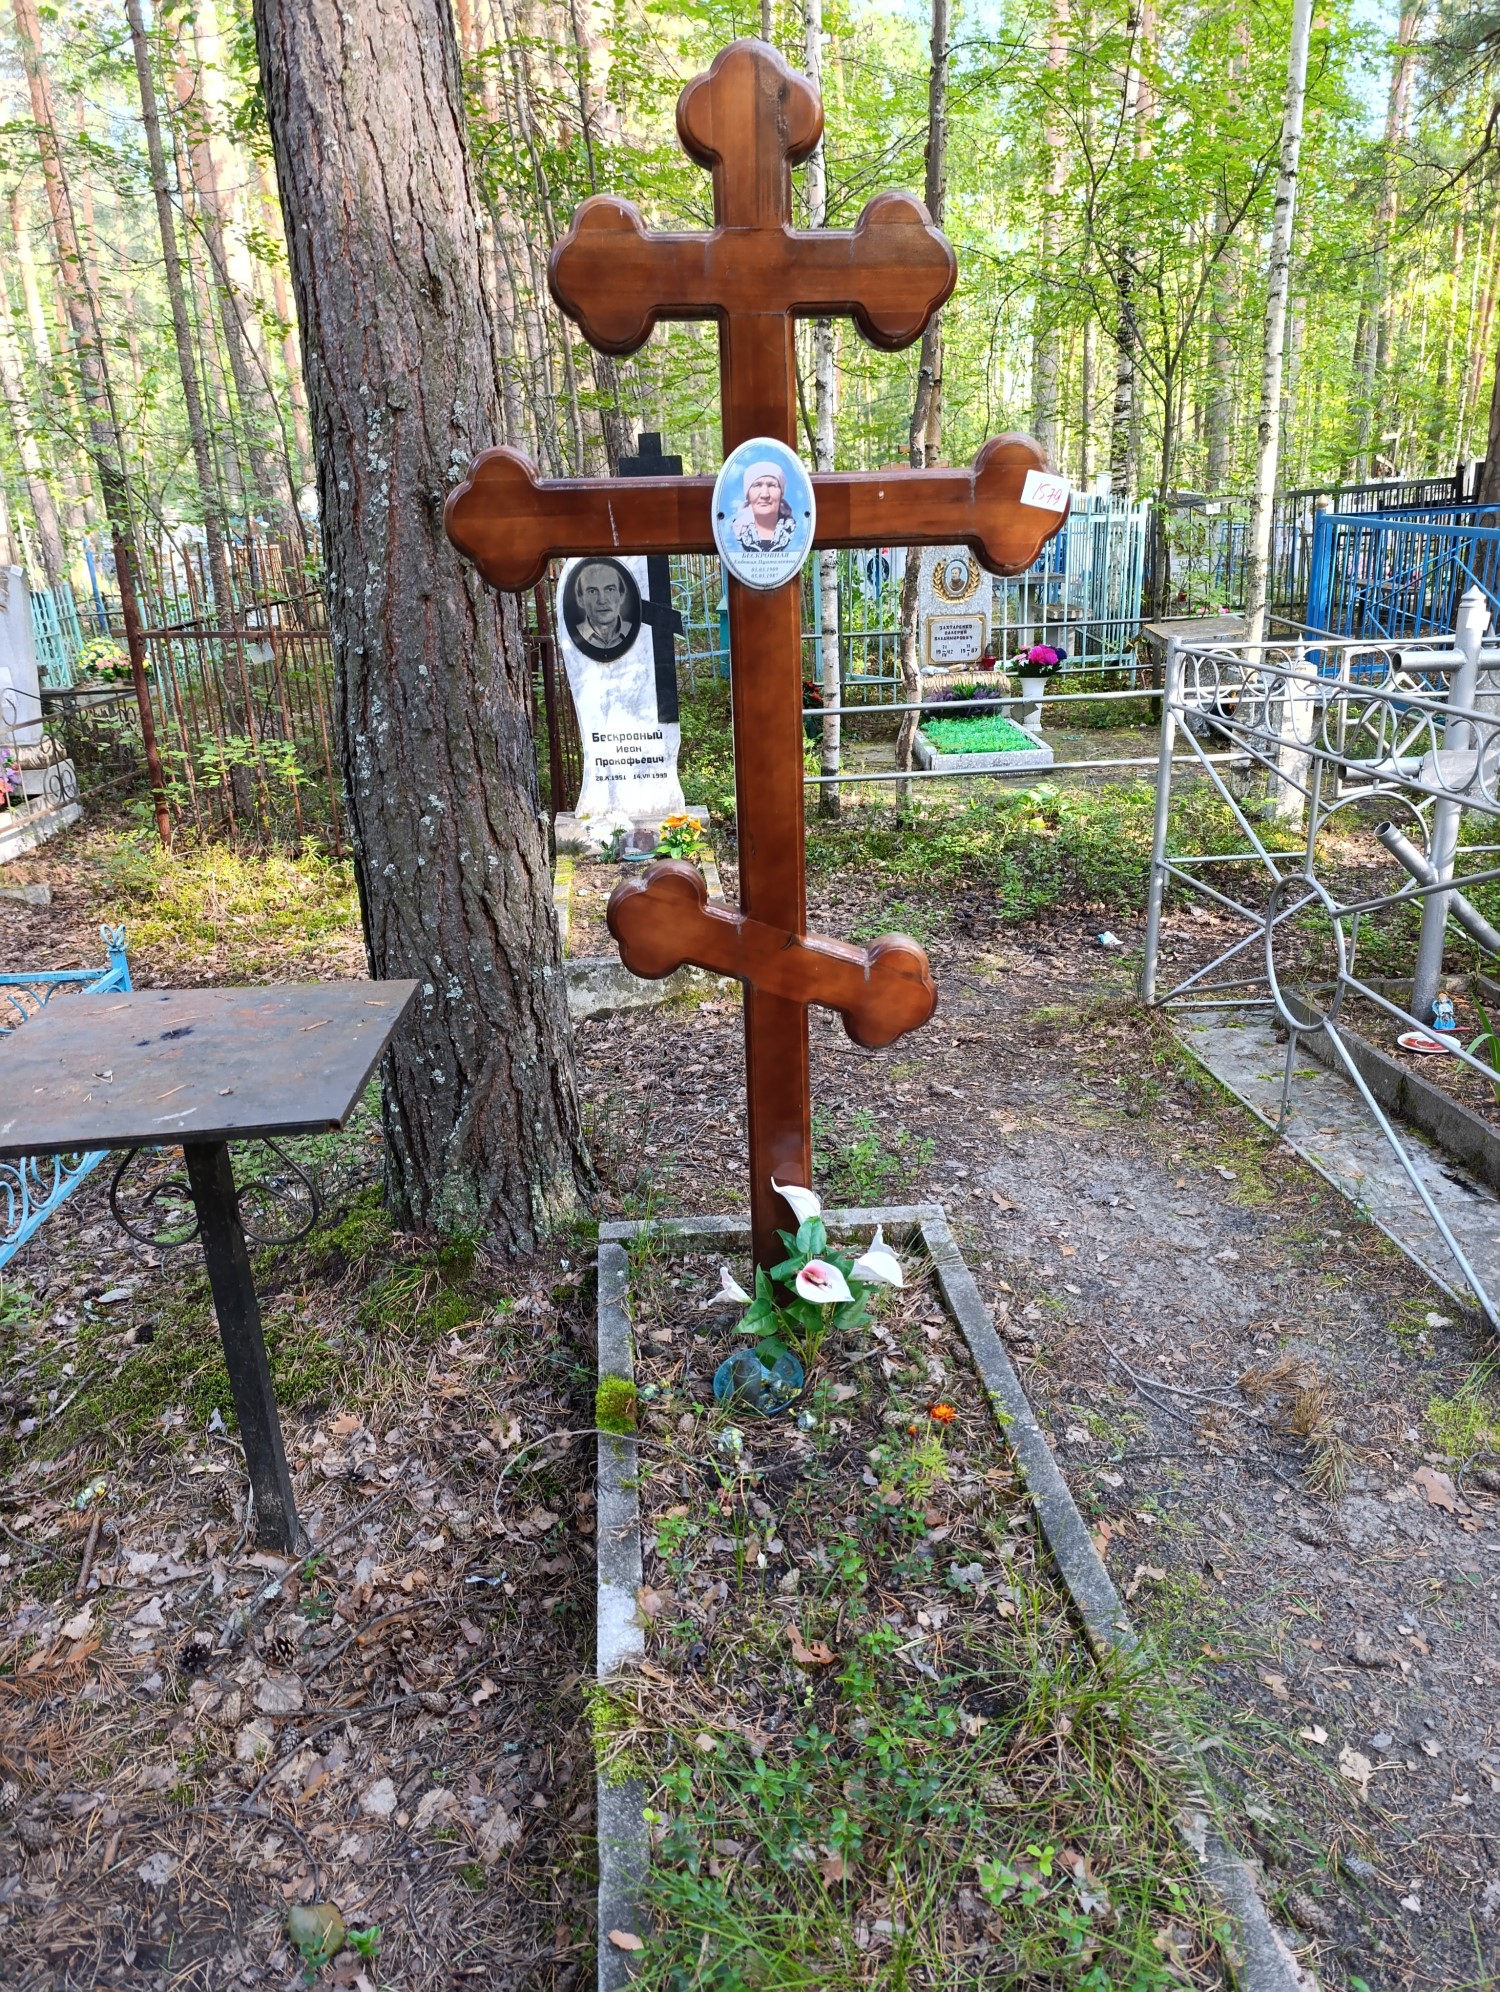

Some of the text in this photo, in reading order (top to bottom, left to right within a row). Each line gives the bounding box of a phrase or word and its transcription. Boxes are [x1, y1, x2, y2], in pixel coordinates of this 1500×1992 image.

[592, 729, 663, 743] Бескровный
[616, 745, 642, 753] Иван
[595, 756, 664, 767] Прокофьевич
